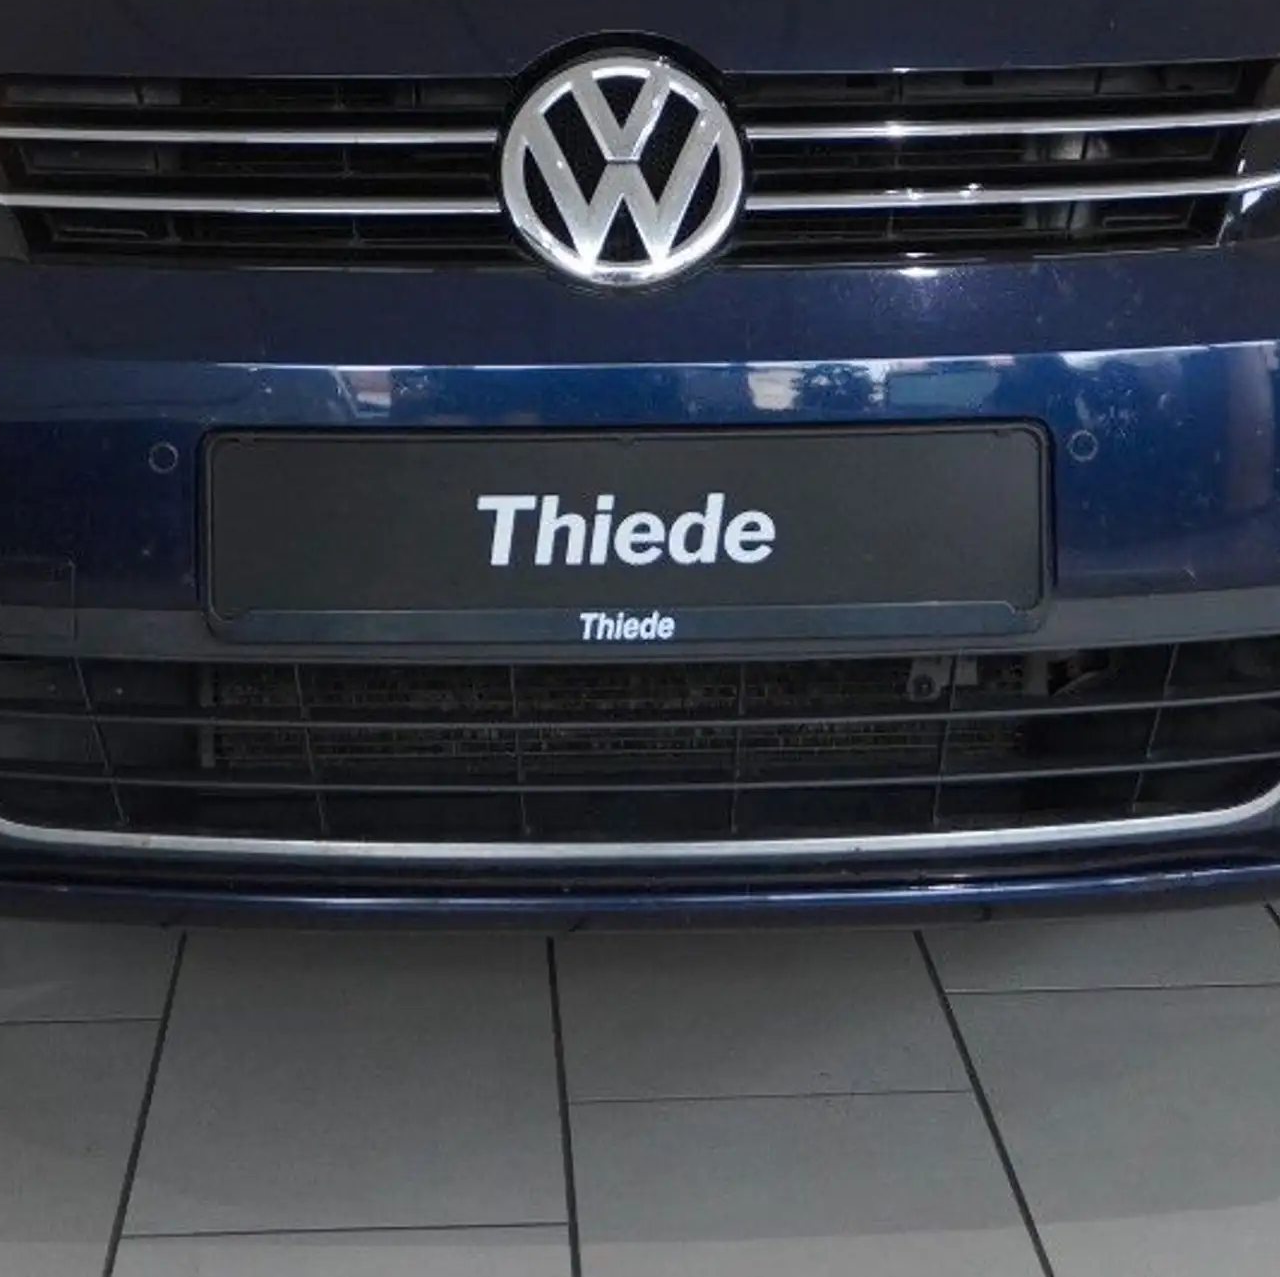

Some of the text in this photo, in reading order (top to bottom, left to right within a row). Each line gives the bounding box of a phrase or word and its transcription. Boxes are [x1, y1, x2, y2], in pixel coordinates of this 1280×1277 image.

[503, 59, 742, 284] VW
[477, 493, 776, 565] Thiede
[579, 611, 675, 640] Thiede
